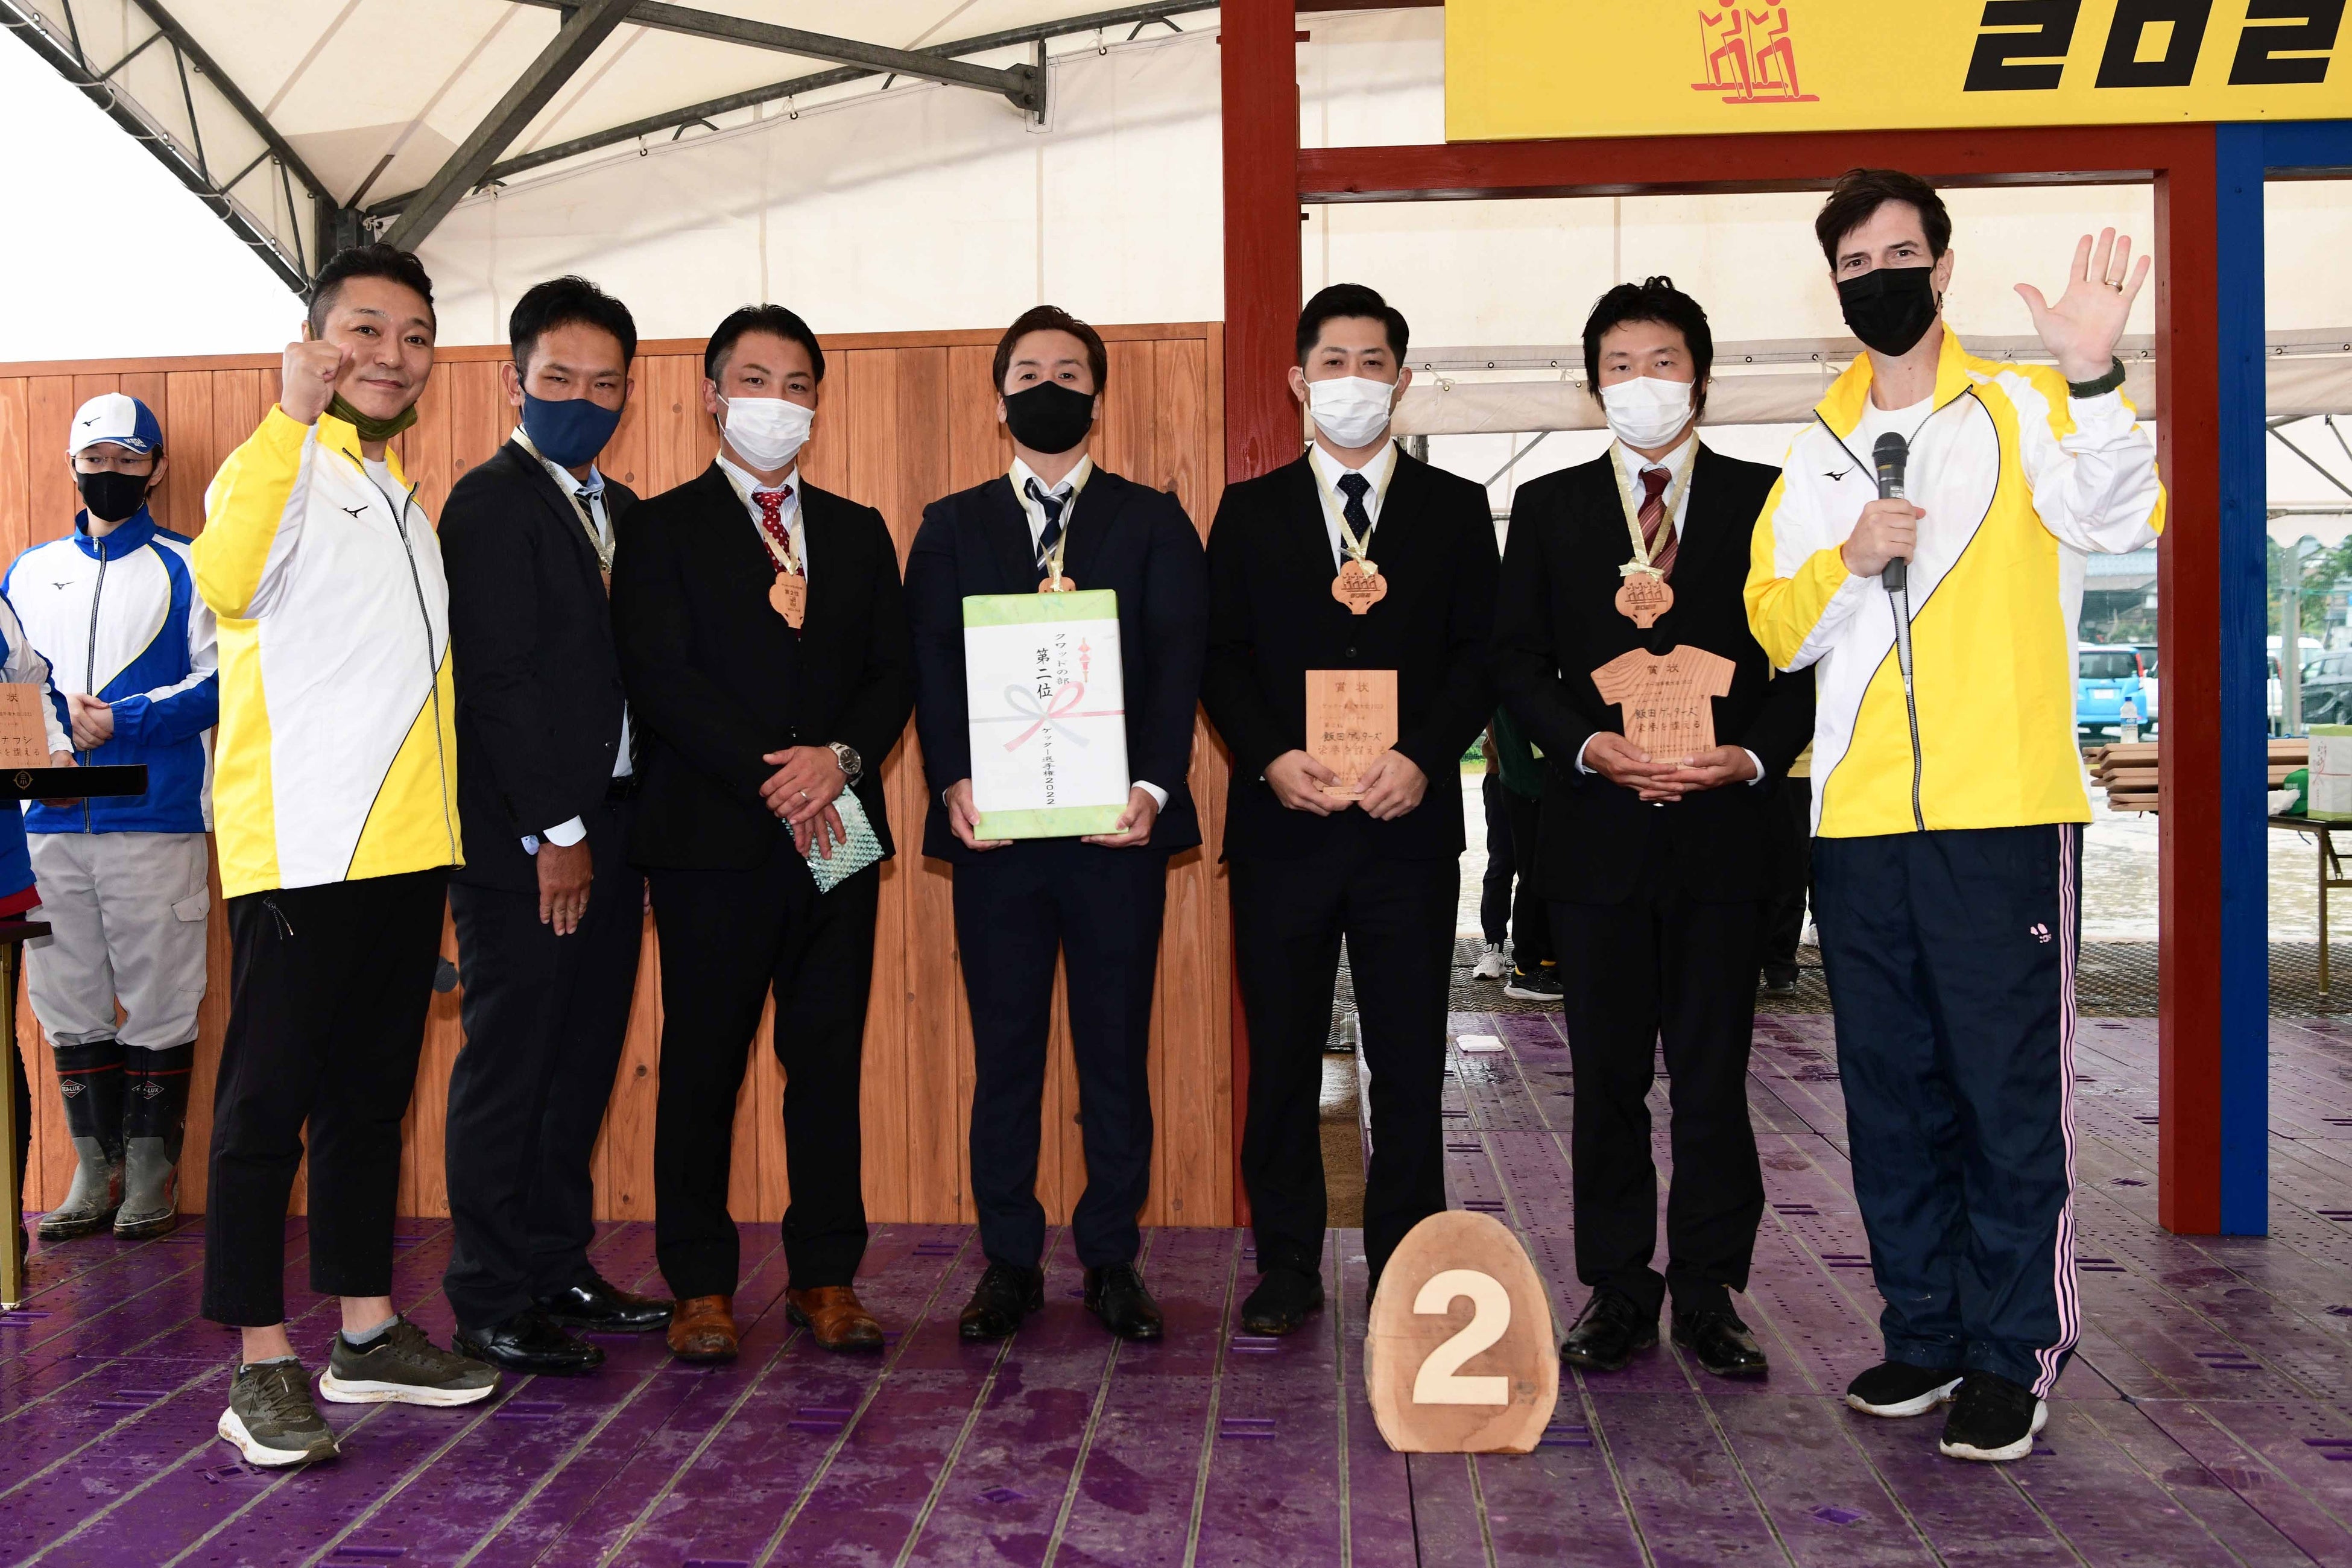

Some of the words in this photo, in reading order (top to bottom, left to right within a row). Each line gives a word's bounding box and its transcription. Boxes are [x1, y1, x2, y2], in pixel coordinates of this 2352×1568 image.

[1036, 648, 1053, 700] 第二位
[1055, 633, 1070, 685] クワッドの部
[1413, 1269, 1511, 1405] 2
